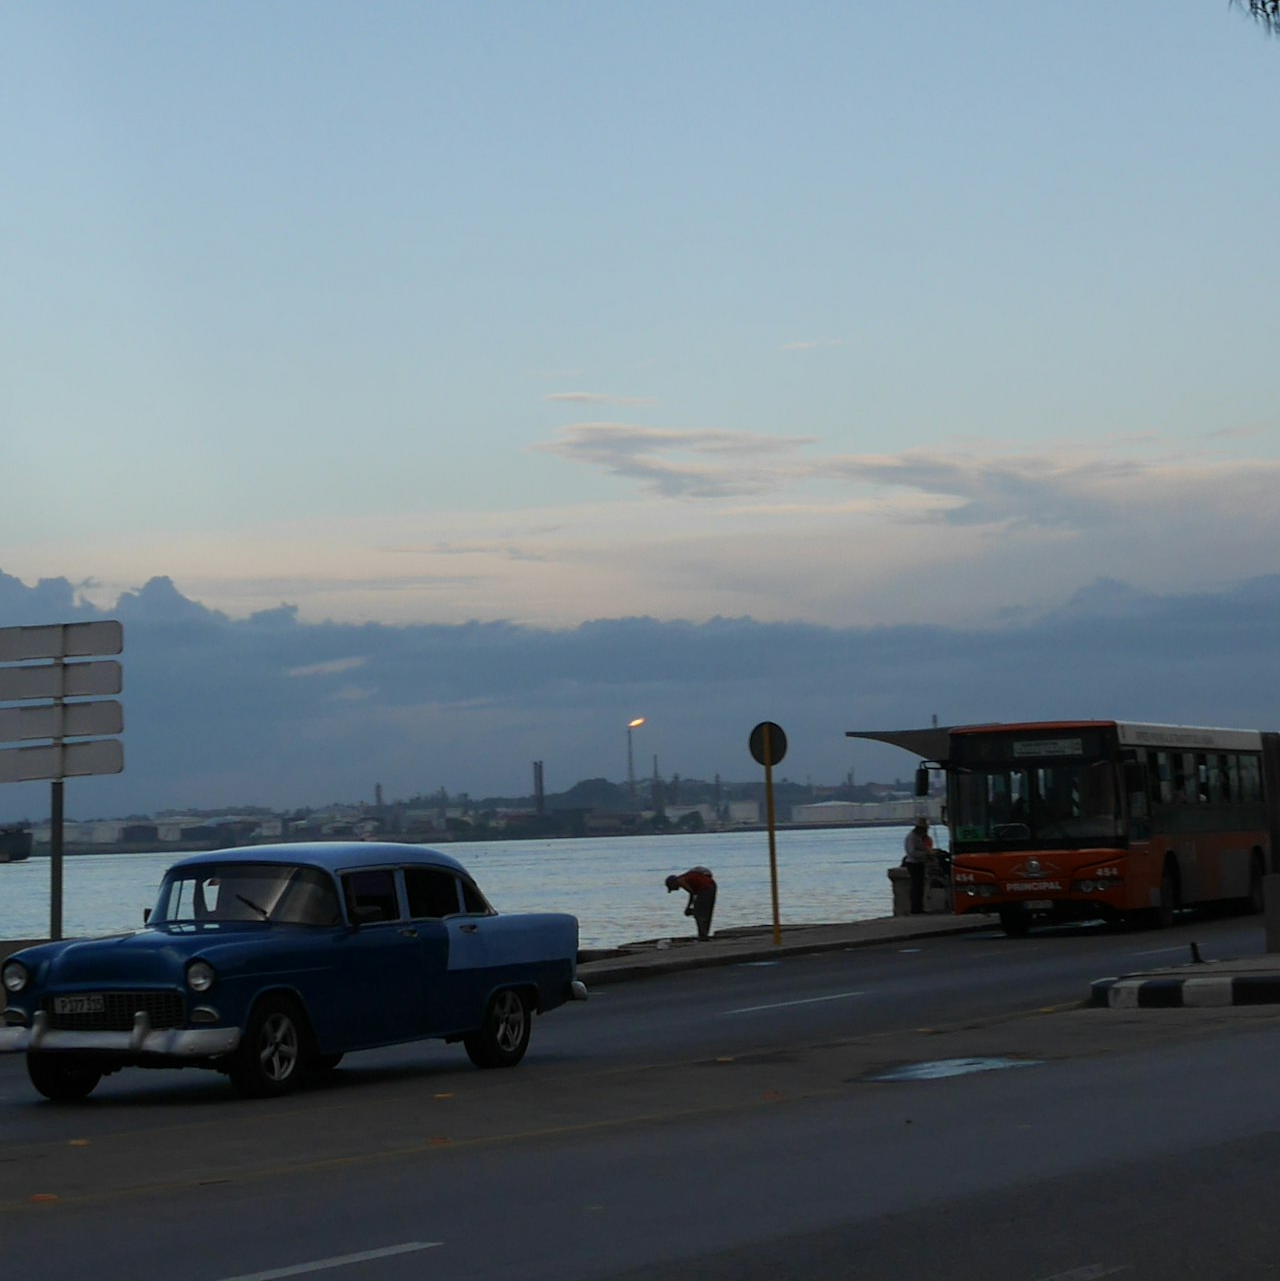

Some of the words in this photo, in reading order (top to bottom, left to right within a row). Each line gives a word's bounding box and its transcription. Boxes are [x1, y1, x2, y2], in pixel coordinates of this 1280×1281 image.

[1095, 866, 1119, 877] 454
[955, 873, 974, 883] 454
[1006, 880, 1062, 892] PRINCIPAL
